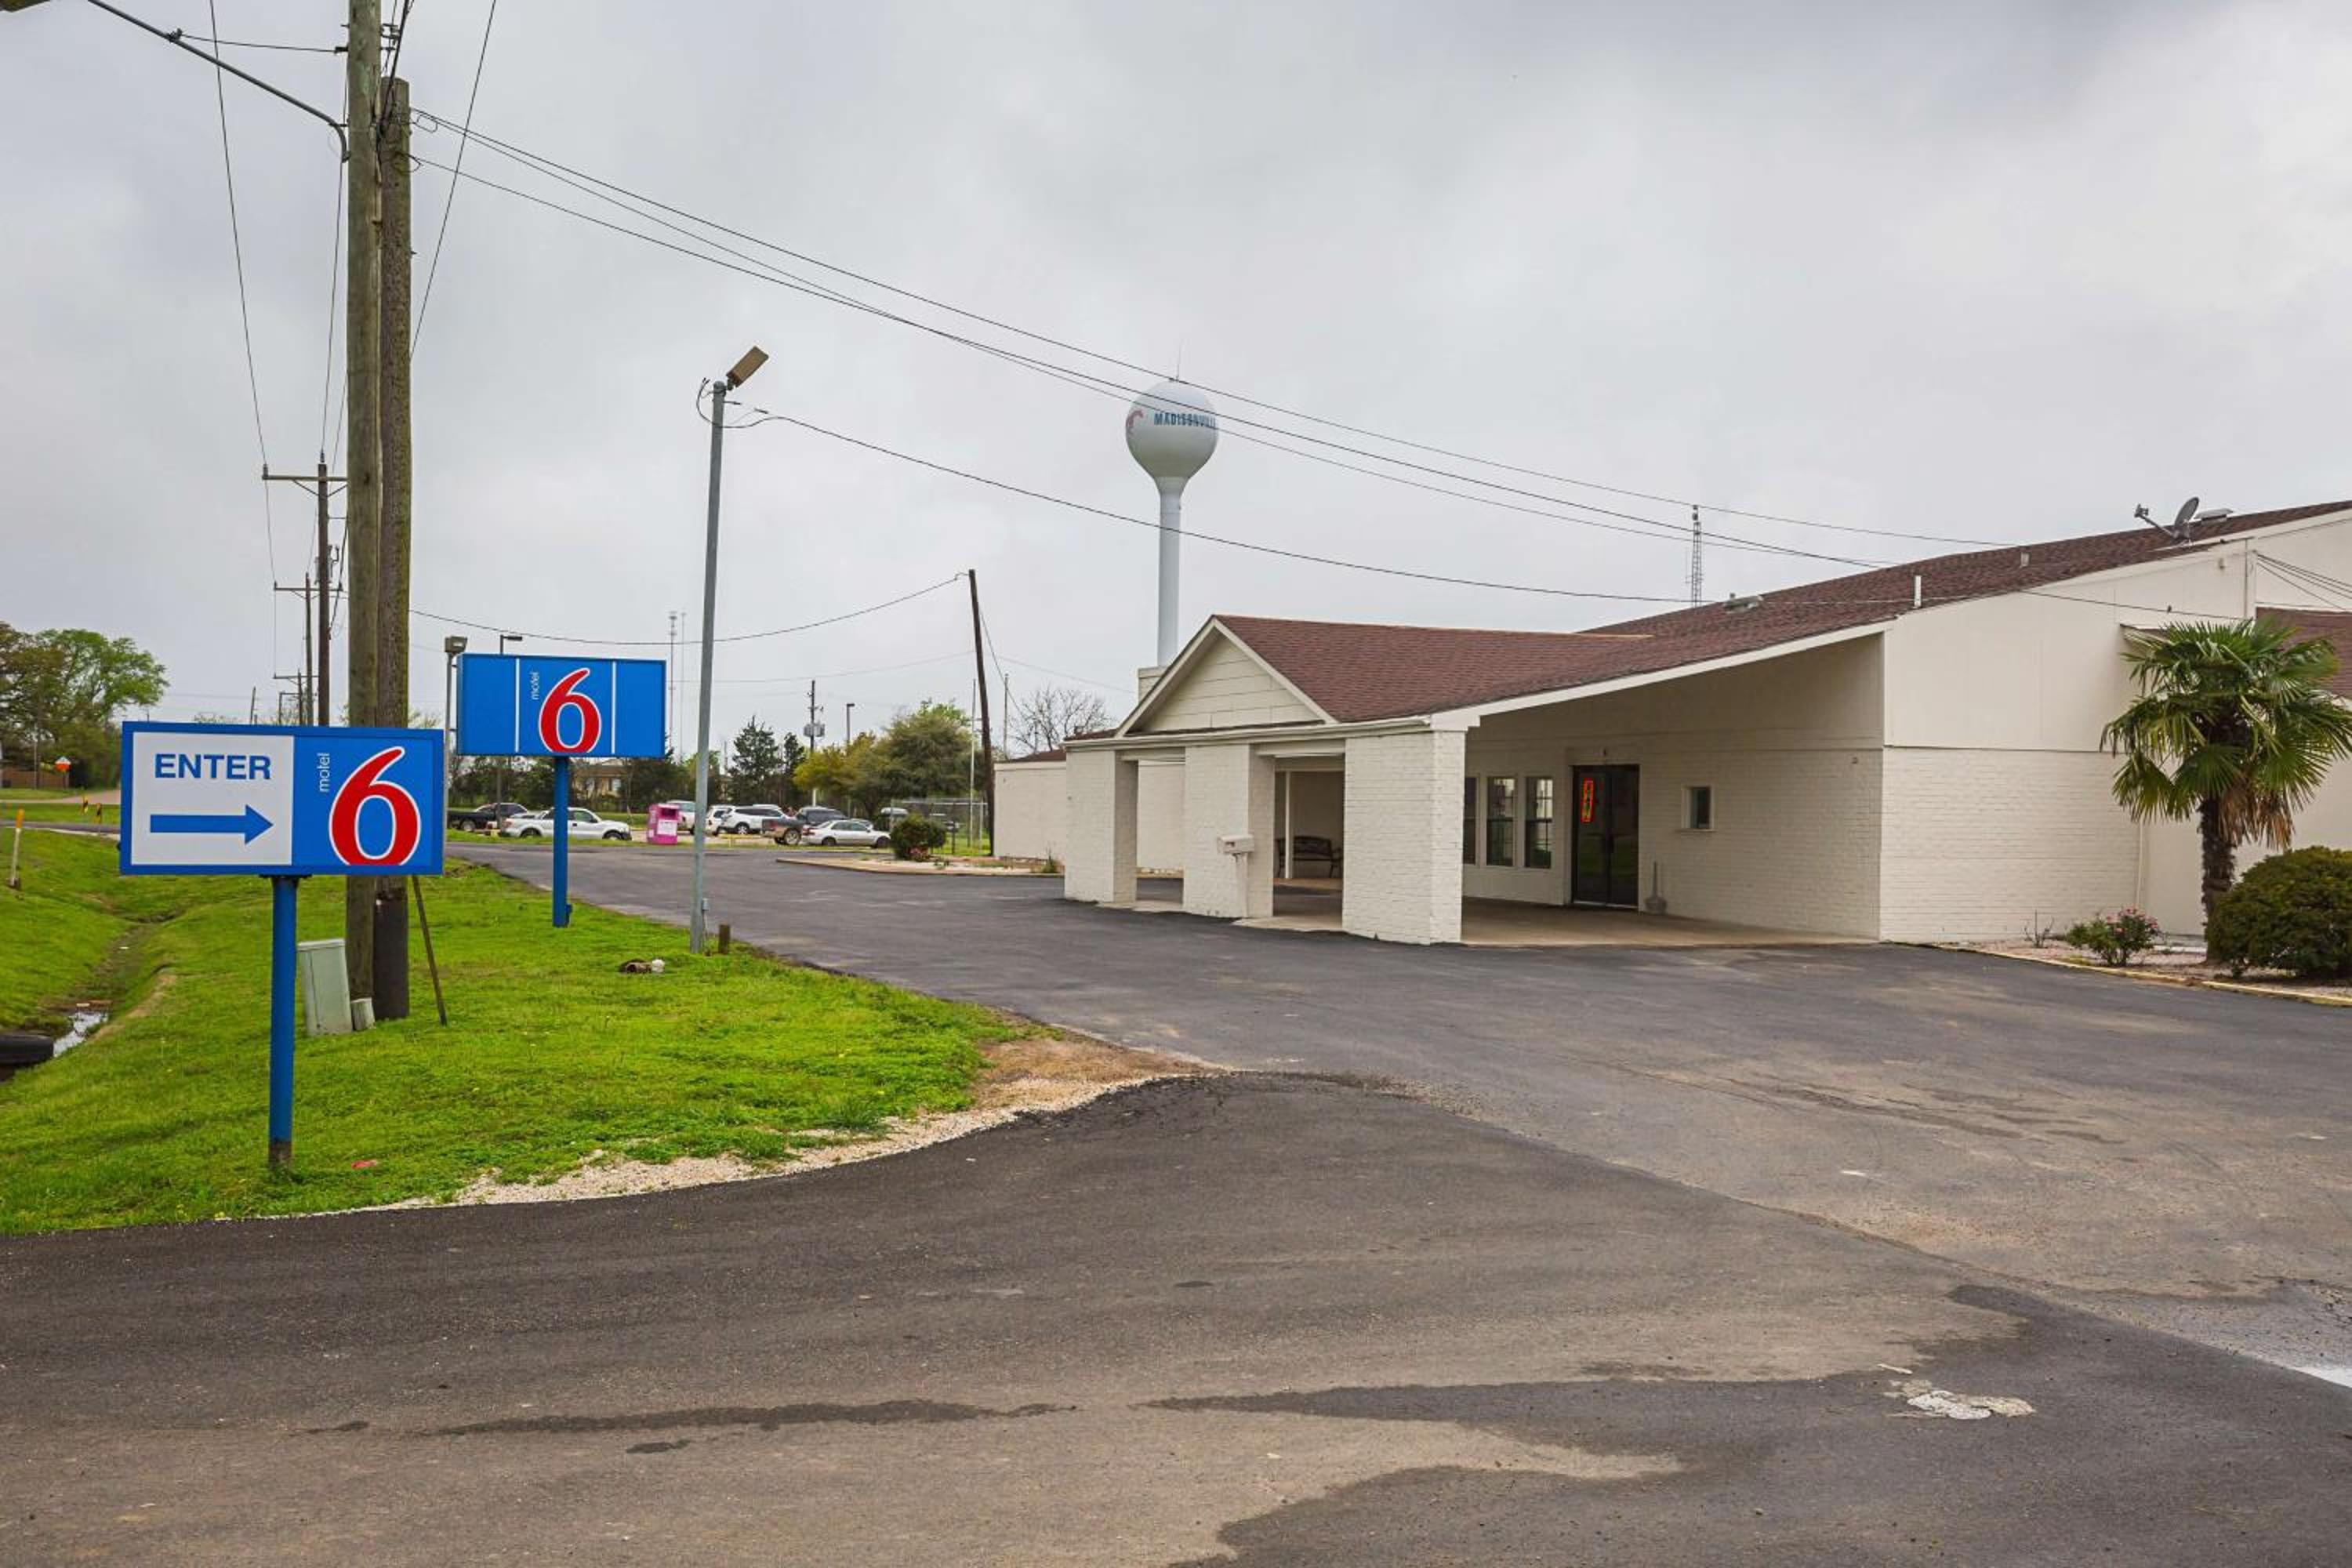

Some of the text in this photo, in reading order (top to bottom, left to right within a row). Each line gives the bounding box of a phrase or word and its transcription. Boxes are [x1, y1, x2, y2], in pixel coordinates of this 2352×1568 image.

[530, 667, 601, 753] motel 6
[154, 753, 271, 780] ENTER
[317, 746, 421, 866] motel 6
